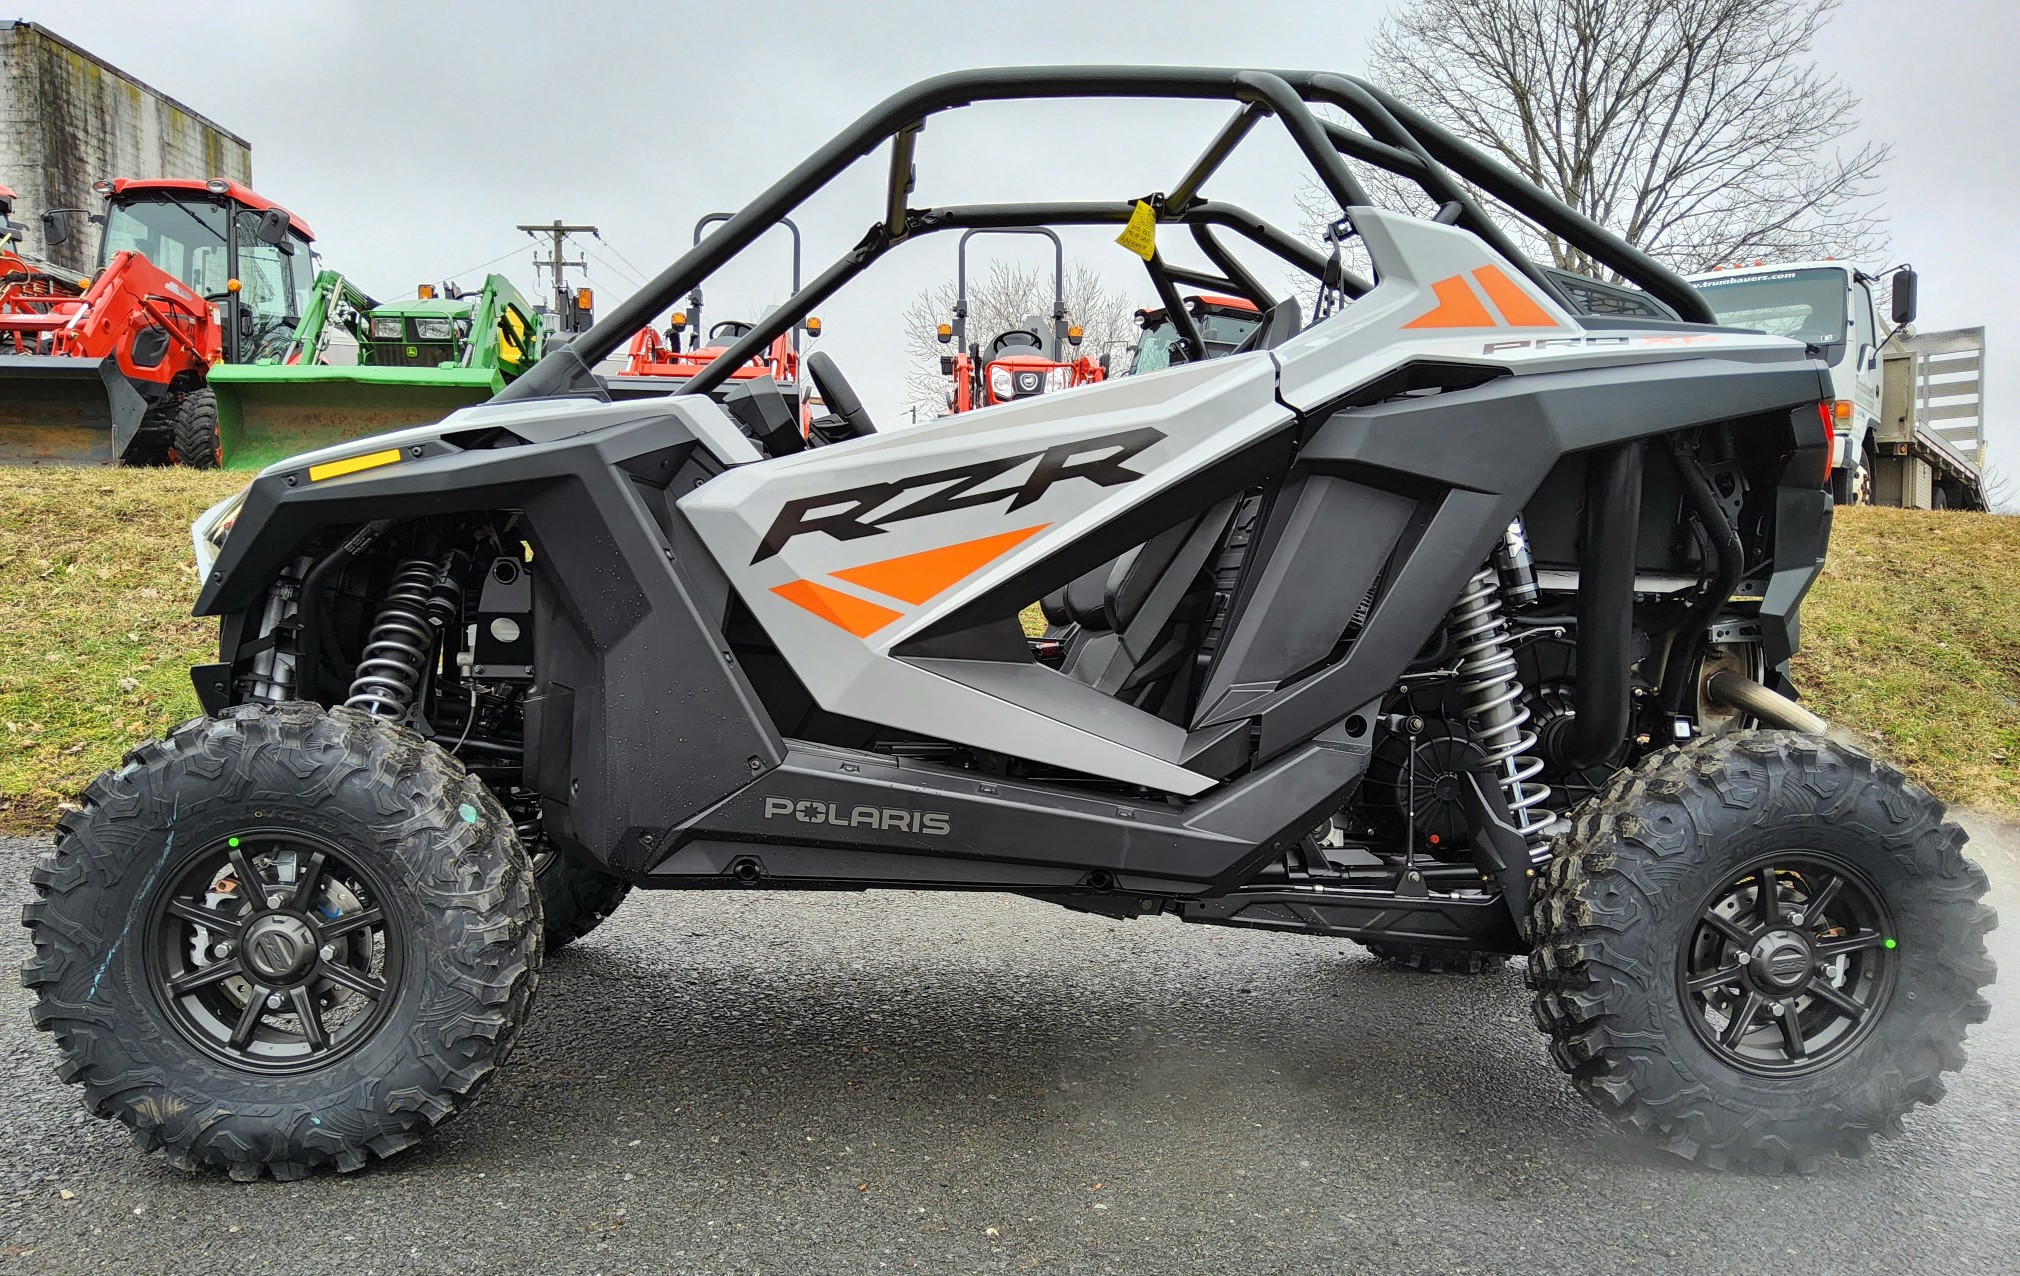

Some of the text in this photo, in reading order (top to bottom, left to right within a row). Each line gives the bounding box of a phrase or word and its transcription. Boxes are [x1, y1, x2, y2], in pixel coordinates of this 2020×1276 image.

[1482, 336, 1629, 355] PRO
[749, 426, 1170, 567] RZR
[764, 796, 951, 836] POLARIS
